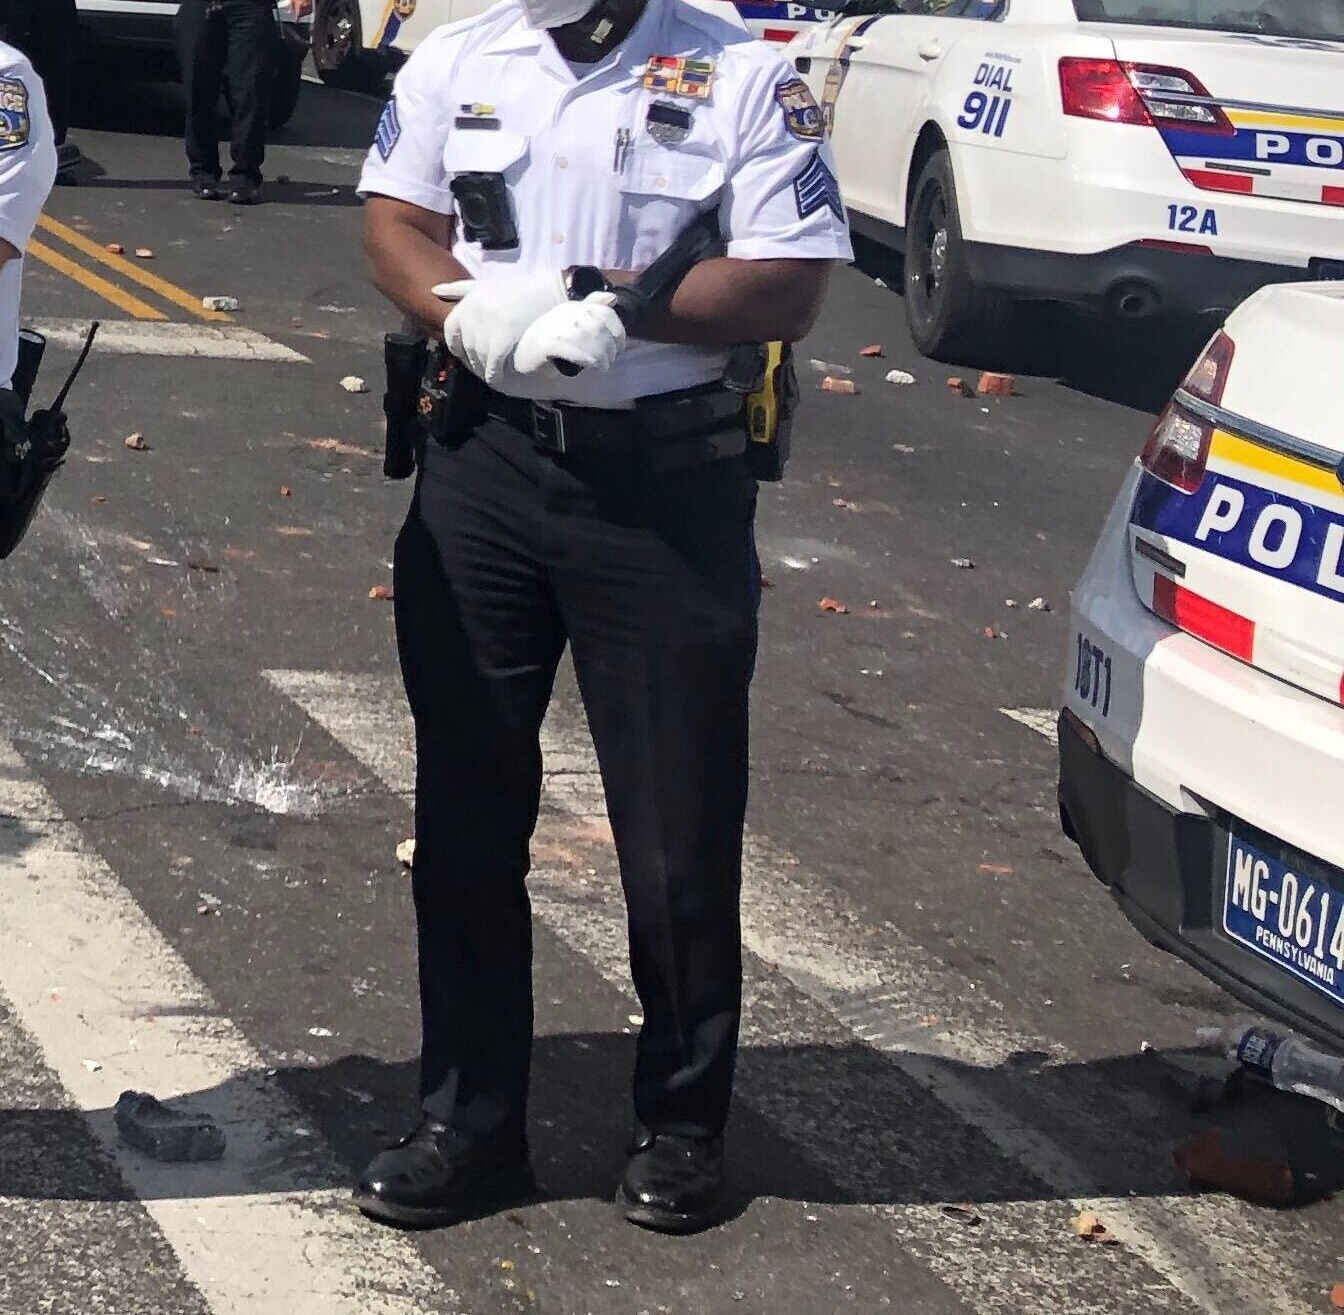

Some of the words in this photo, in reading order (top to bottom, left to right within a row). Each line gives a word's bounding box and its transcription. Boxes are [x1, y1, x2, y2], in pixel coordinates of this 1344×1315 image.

[973, 62, 1013, 93] DIAL
[957, 91, 1012, 139] 911
[1255, 132, 1344, 166] PO
[1167, 204, 1218, 236] 12A
[1194, 483, 1344, 595] POL
[1255, 925, 1336, 986] PENNSYLVANIA
